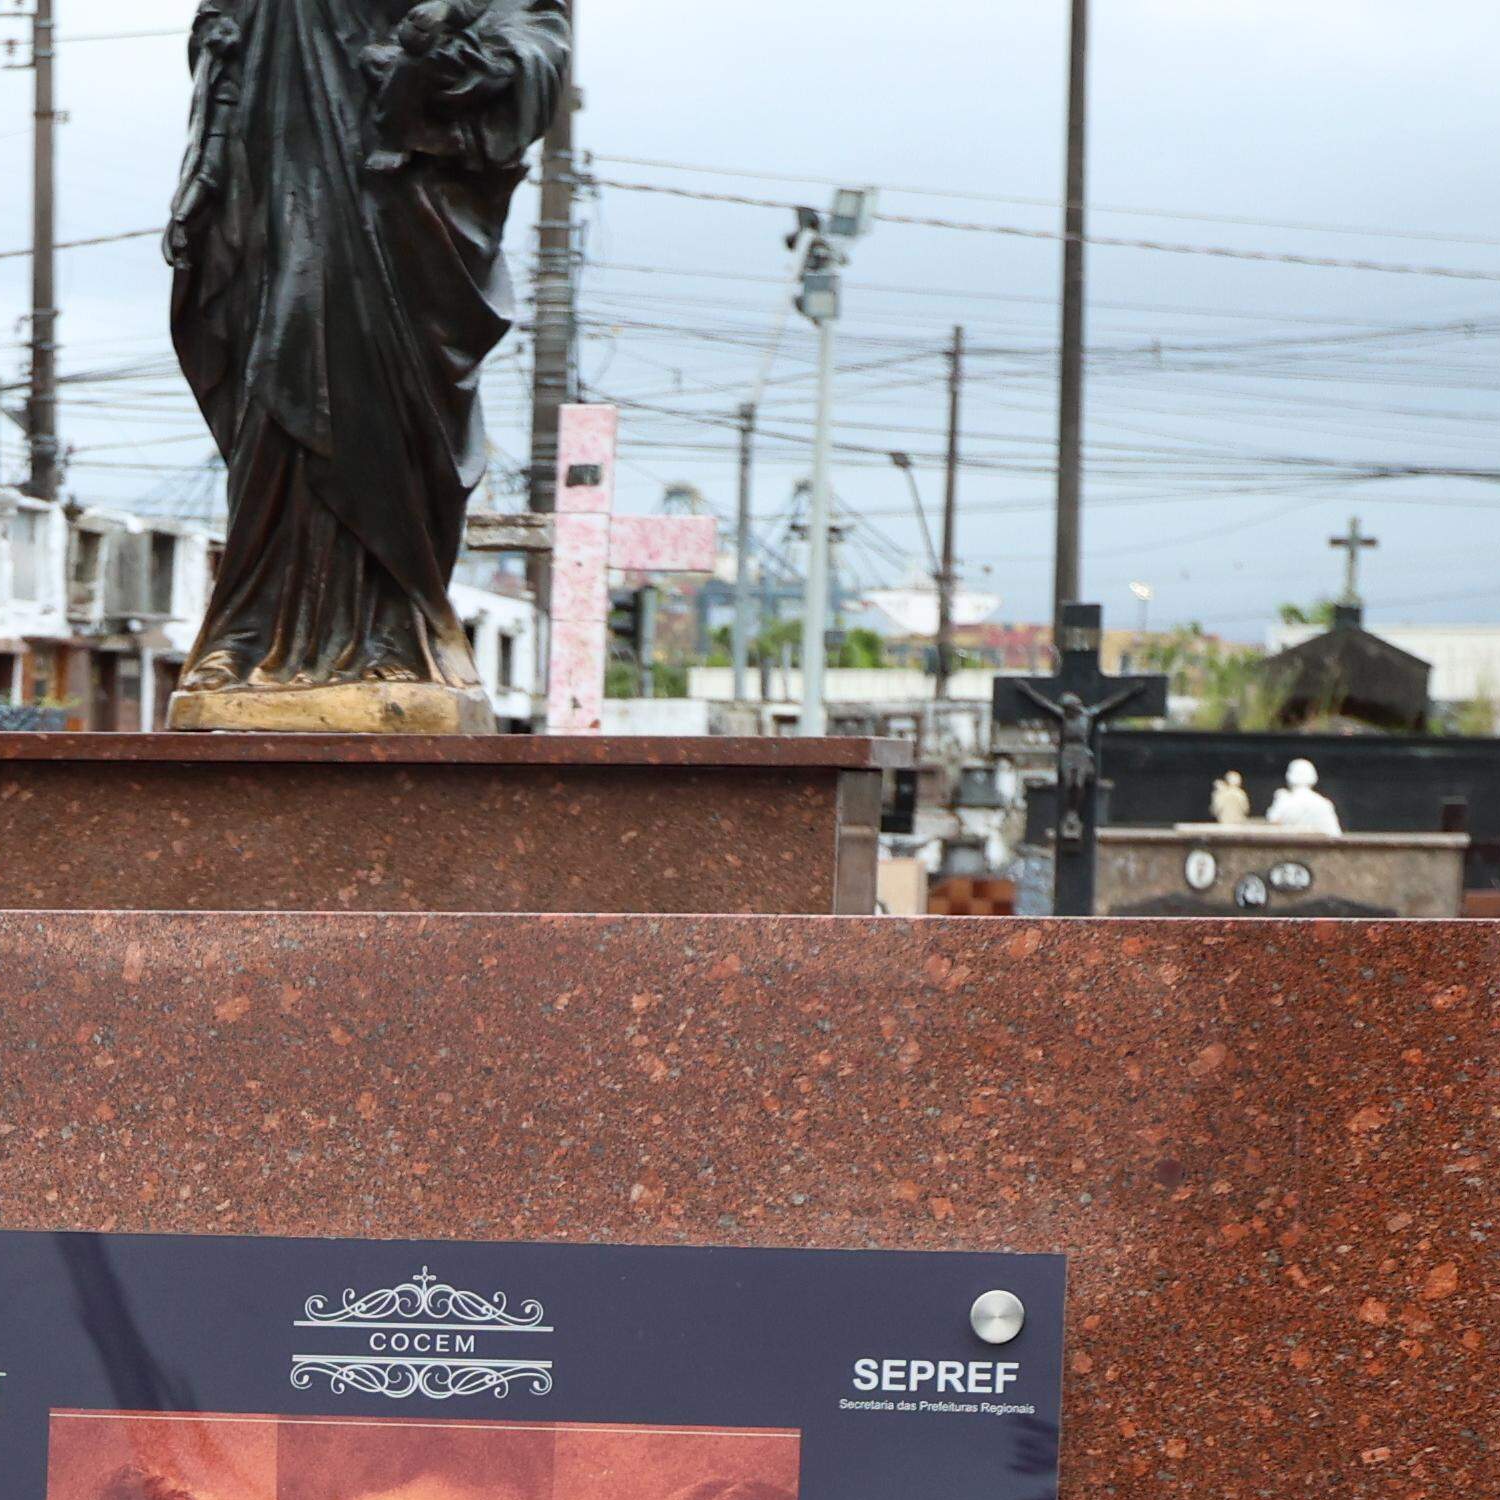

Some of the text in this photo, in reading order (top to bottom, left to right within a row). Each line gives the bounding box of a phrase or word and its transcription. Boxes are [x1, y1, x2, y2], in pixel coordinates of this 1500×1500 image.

[369, 1332, 476, 1353] COCEM
[852, 1358, 1020, 1394] SEPREF
[839, 1398, 1036, 1416] Secretaria das Prefeituras Regionais
